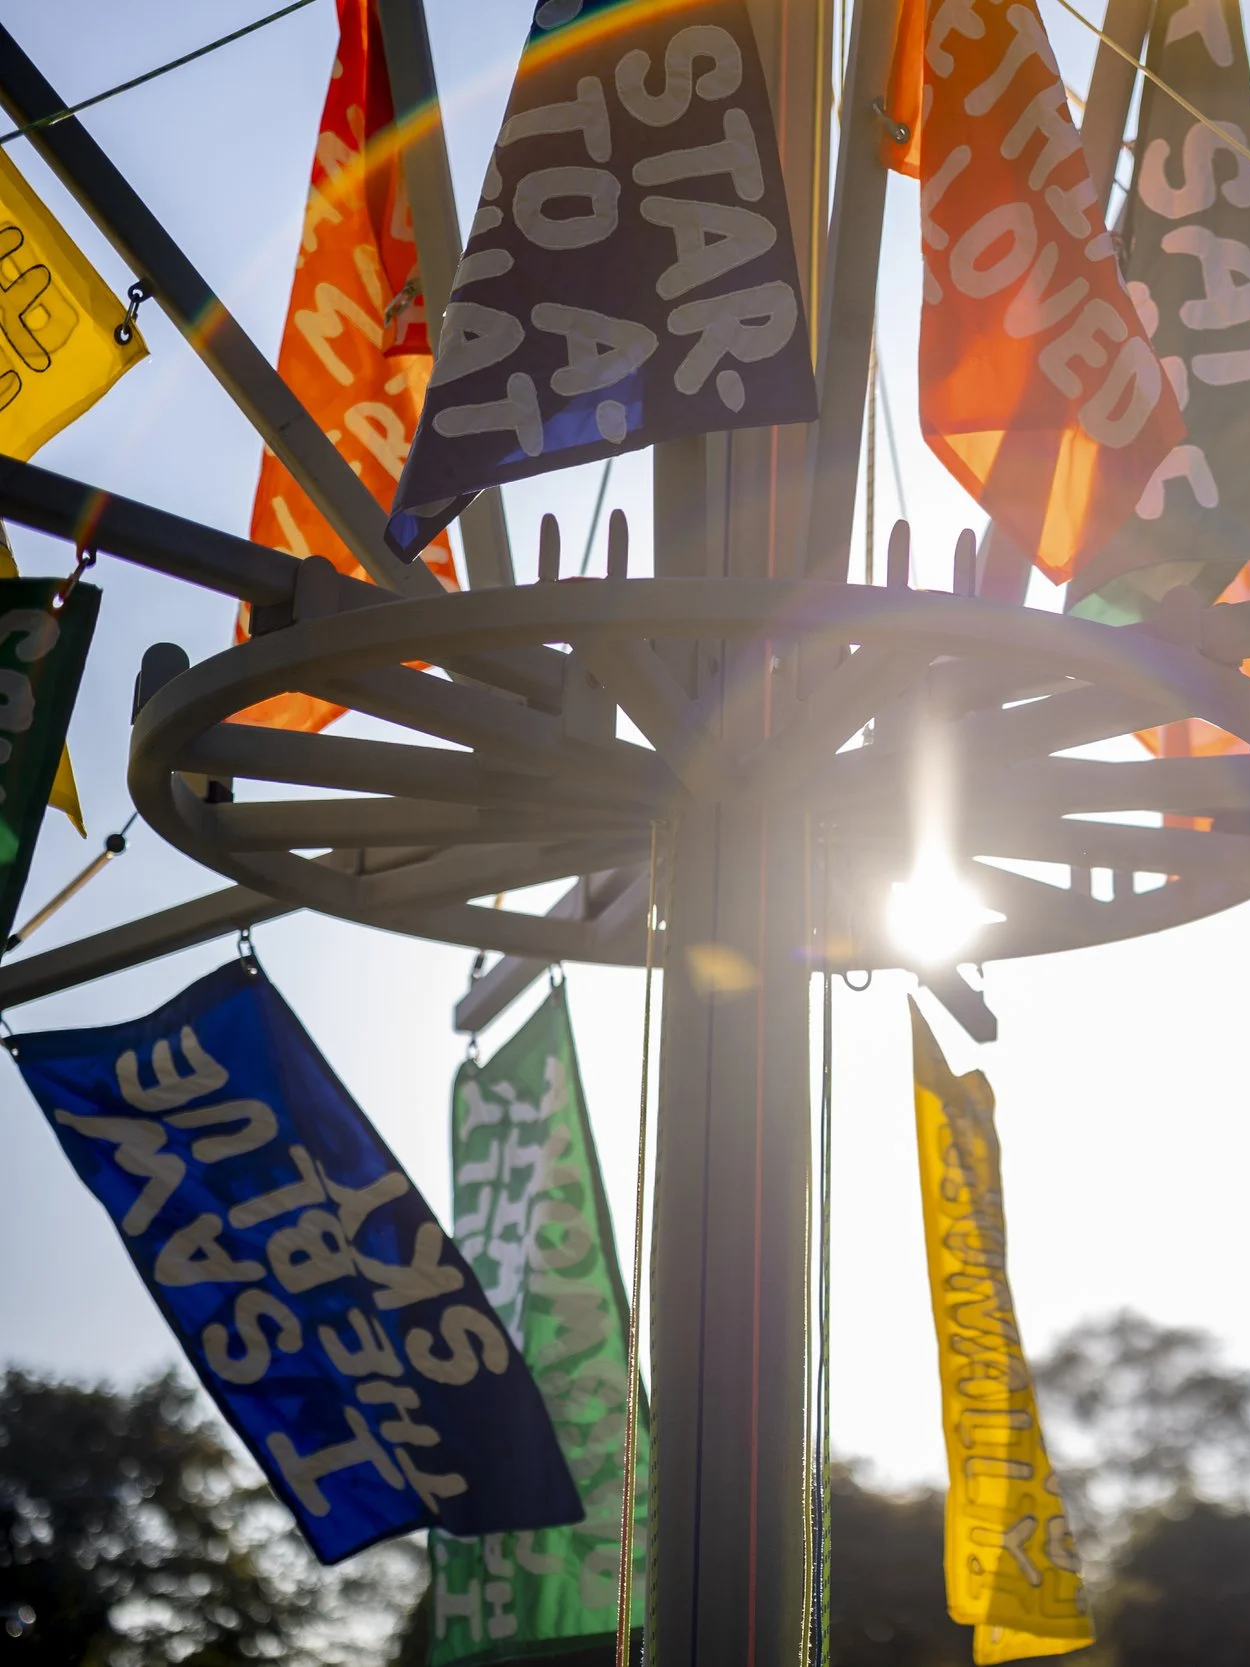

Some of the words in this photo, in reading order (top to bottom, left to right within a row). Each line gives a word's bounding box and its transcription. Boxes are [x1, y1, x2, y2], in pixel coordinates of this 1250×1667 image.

[501, 76, 621, 250] TO
[616, 25, 798, 413] STAR-
[921, 145, 1162, 449] LOVED
[55, 1107, 302, 1384] SAW
[116, 1025, 358, 1294] BLUE
[331, 1171, 509, 1385] SKY
[265, 1405, 407, 1517] I
[317, 1307, 467, 1514] THE
